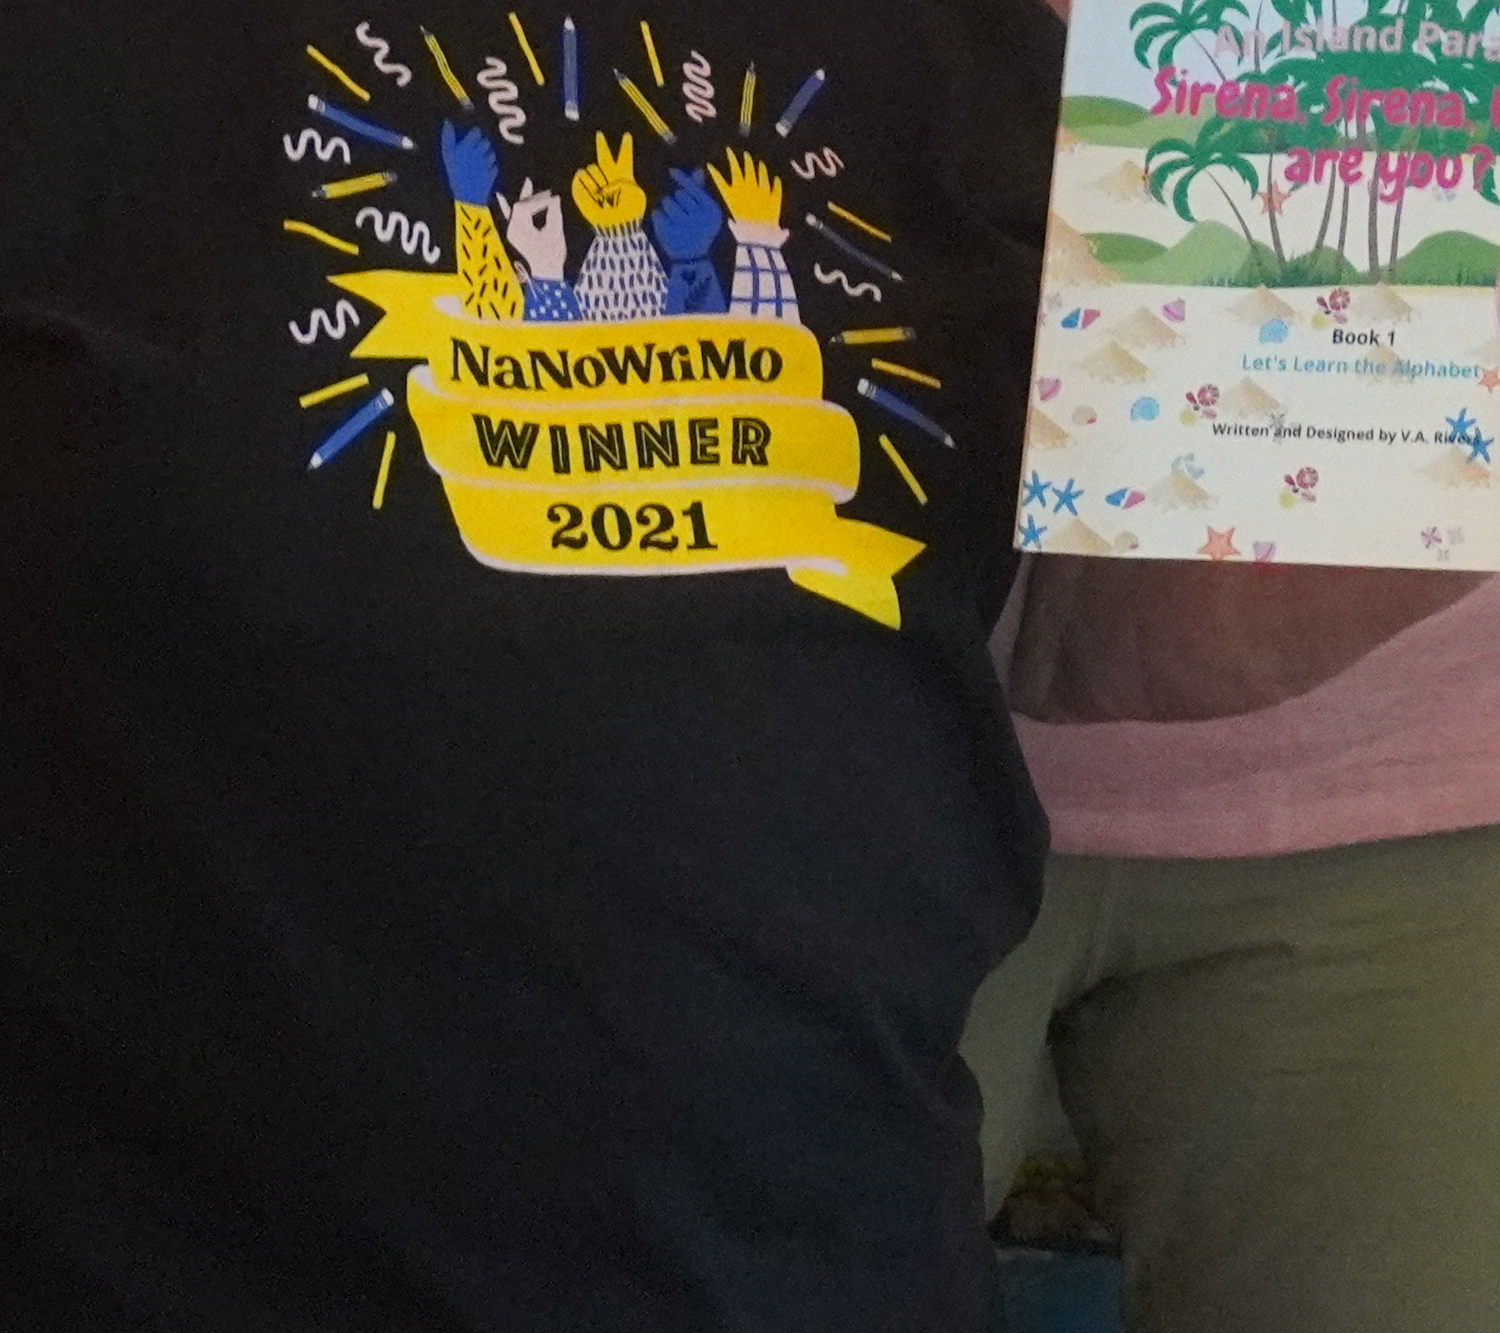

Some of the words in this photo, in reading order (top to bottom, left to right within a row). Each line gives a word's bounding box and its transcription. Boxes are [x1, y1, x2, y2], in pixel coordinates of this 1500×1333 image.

[1214, 23, 1266, 60] An
[1281, 18, 1403, 53] Island
[1150, 64, 1307, 125] Sirena,
[1322, 73, 1474, 129] Sirena,
[1284, 147, 1364, 185] are
[1376, 143, 1497, 204] you?
[1332, 328, 1380, 345] Book
[1387, 330, 1396, 346] 1
[451, 337, 784, 391] NaNoWriMo
[1241, 354, 1287, 371] Let's
[1293, 356, 1348, 374] Learn
[1354, 358, 1386, 375] the
[1393, 360, 1480, 380] Alphabet
[471, 412, 773, 475] WINNER
[1212, 422, 1269, 437] Written
[1275, 425, 1301, 439] and
[1306, 426, 1375, 443] Designed
[1379, 428, 1397, 445] by
[546, 499, 719, 552] 2021
